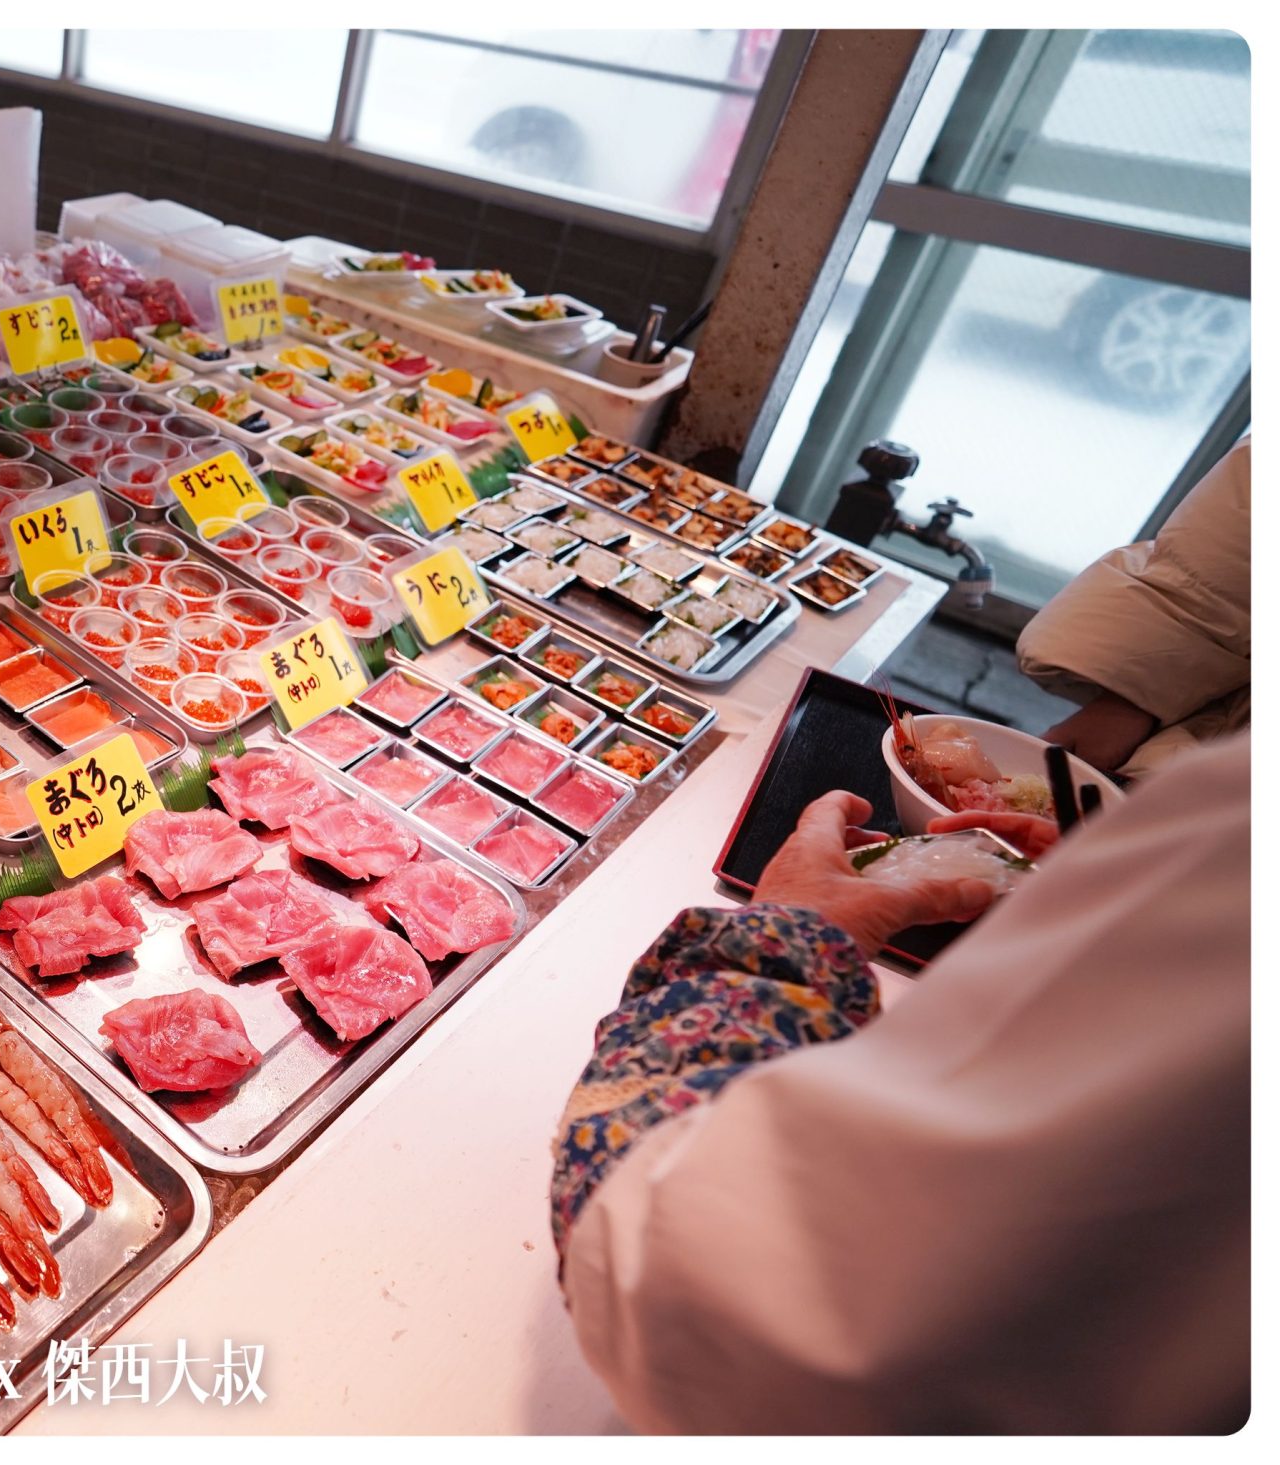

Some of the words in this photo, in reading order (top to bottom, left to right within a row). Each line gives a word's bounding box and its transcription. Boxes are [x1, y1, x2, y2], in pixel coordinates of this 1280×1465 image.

[180, 464, 225, 497] すじこ
[18, 507, 67, 545] いくら
[406, 572, 448, 606] うに
[270, 632, 325, 679] まぐろ
[43, 757, 108, 816] まぐろ
[109, 774, 151, 817] 2枚
